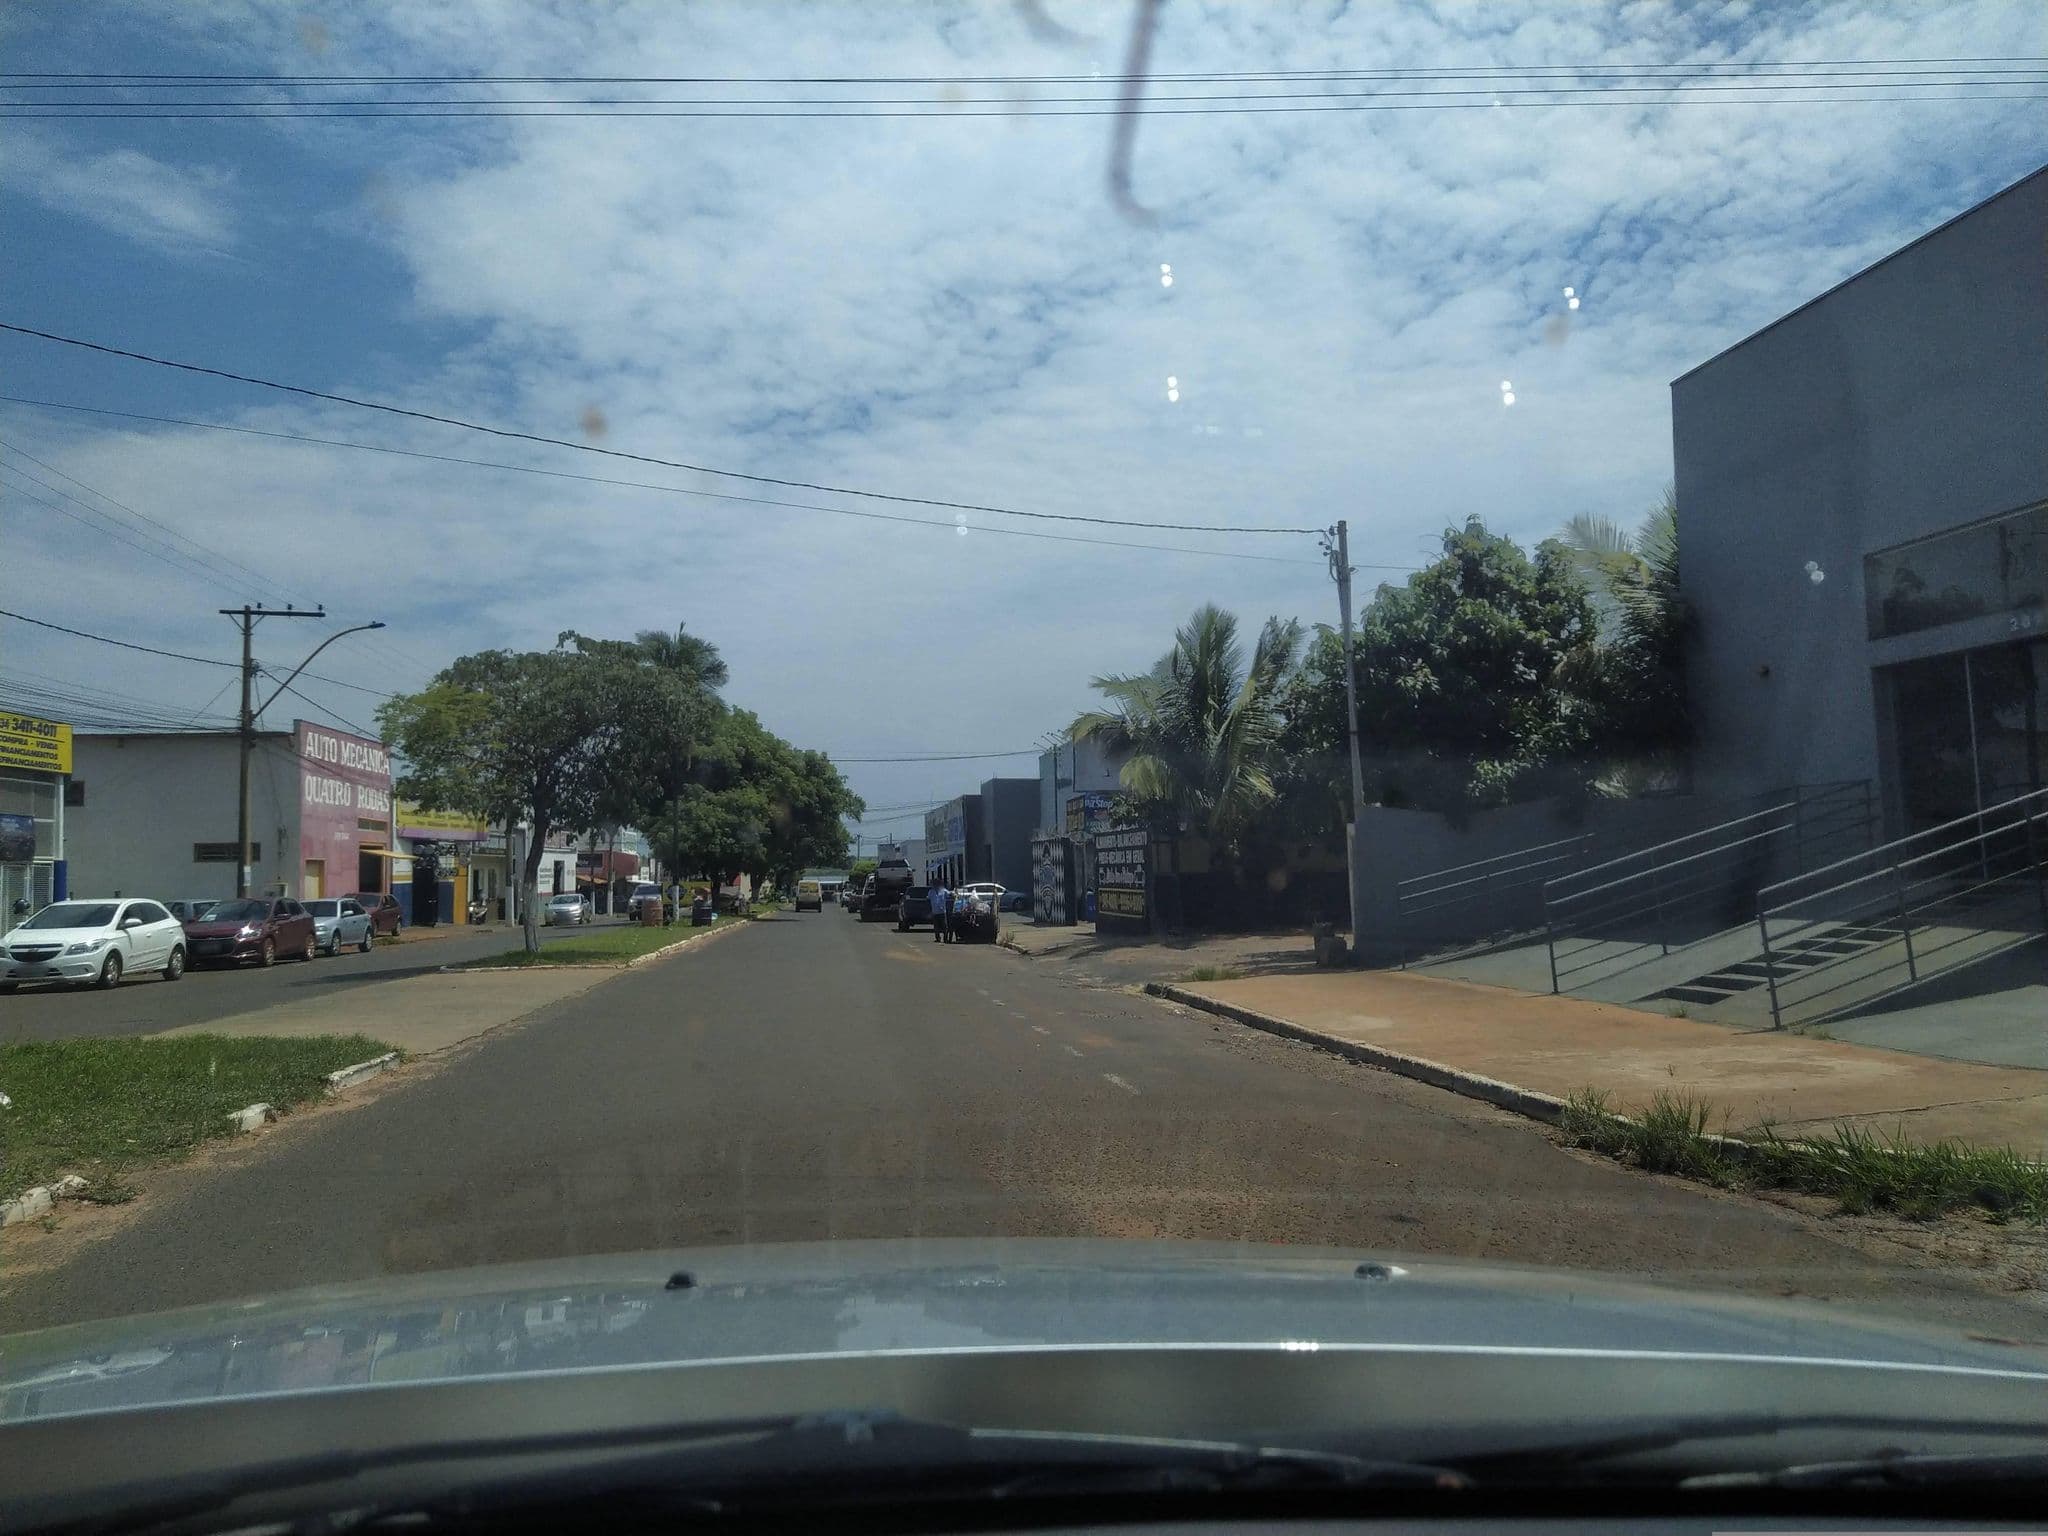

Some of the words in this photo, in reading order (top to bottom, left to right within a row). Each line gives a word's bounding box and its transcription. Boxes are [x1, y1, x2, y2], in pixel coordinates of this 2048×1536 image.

[11, 717, 57, 738] 3411-4011
[304, 732, 336, 762] AUTO
[341, 742, 391, 775] MECÂNICA
[305, 775, 351, 807] QUATRO
[357, 784, 391, 813] RODAS
